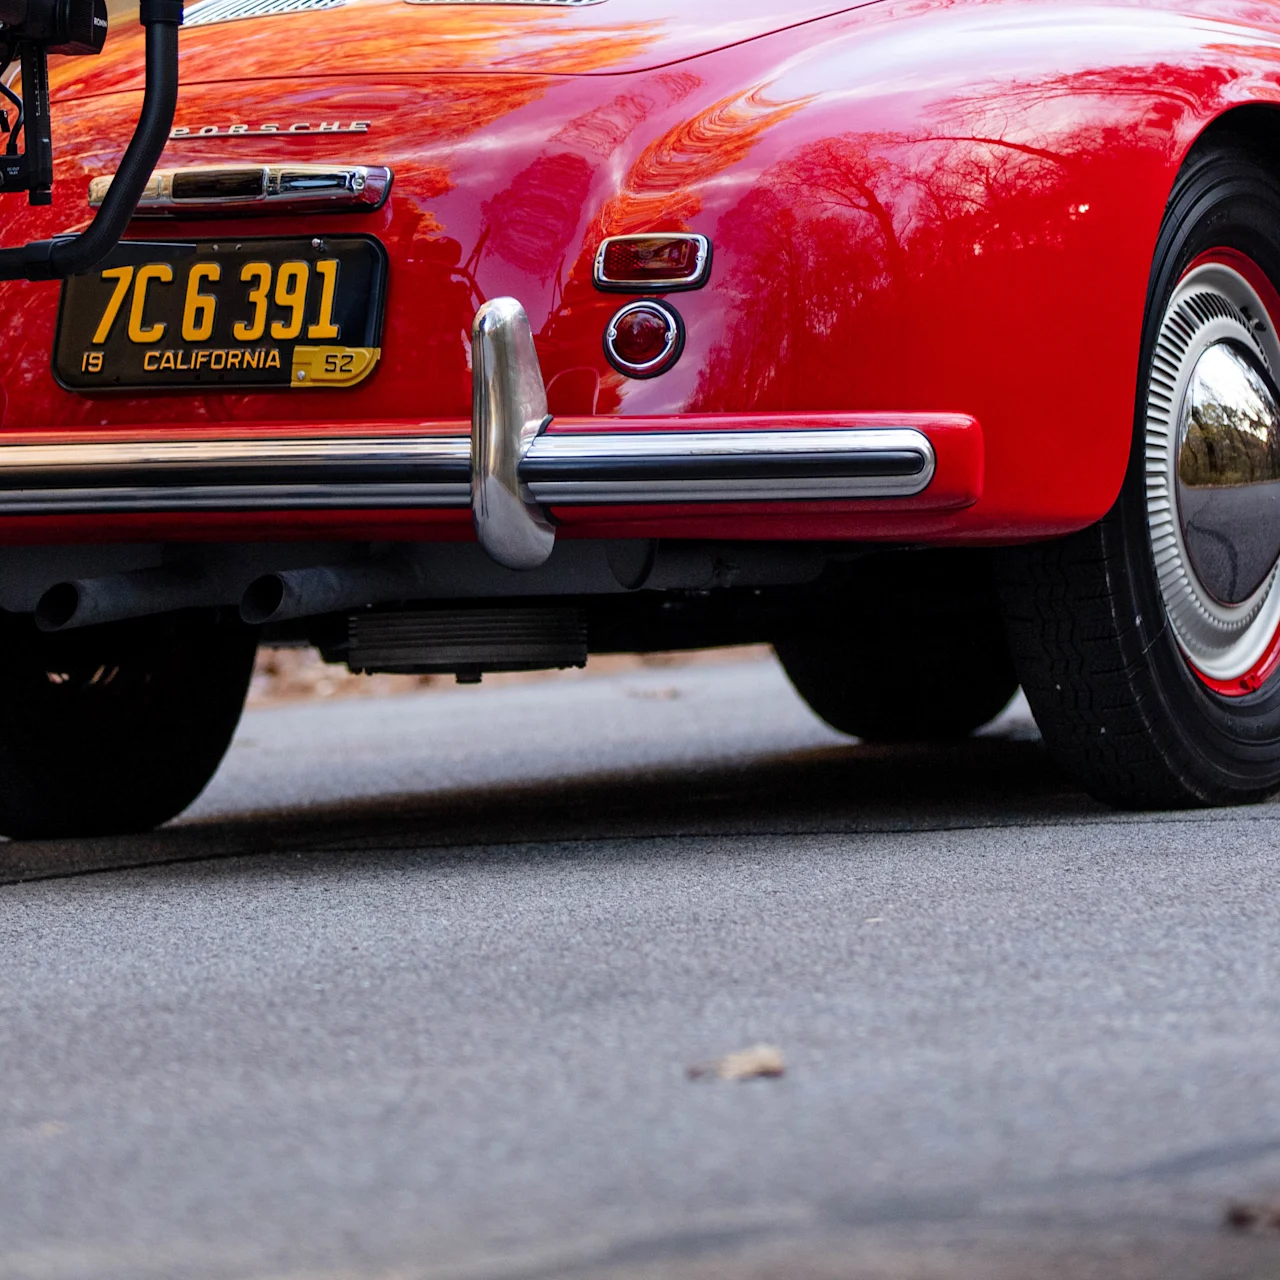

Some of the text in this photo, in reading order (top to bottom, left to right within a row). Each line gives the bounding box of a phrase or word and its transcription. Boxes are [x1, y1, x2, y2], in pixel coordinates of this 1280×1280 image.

[170, 121, 371, 138] PORSCHE
[92, 259, 340, 345] 7C 6 391
[81, 349, 354, 374] 19 CALIFORNIA 52
